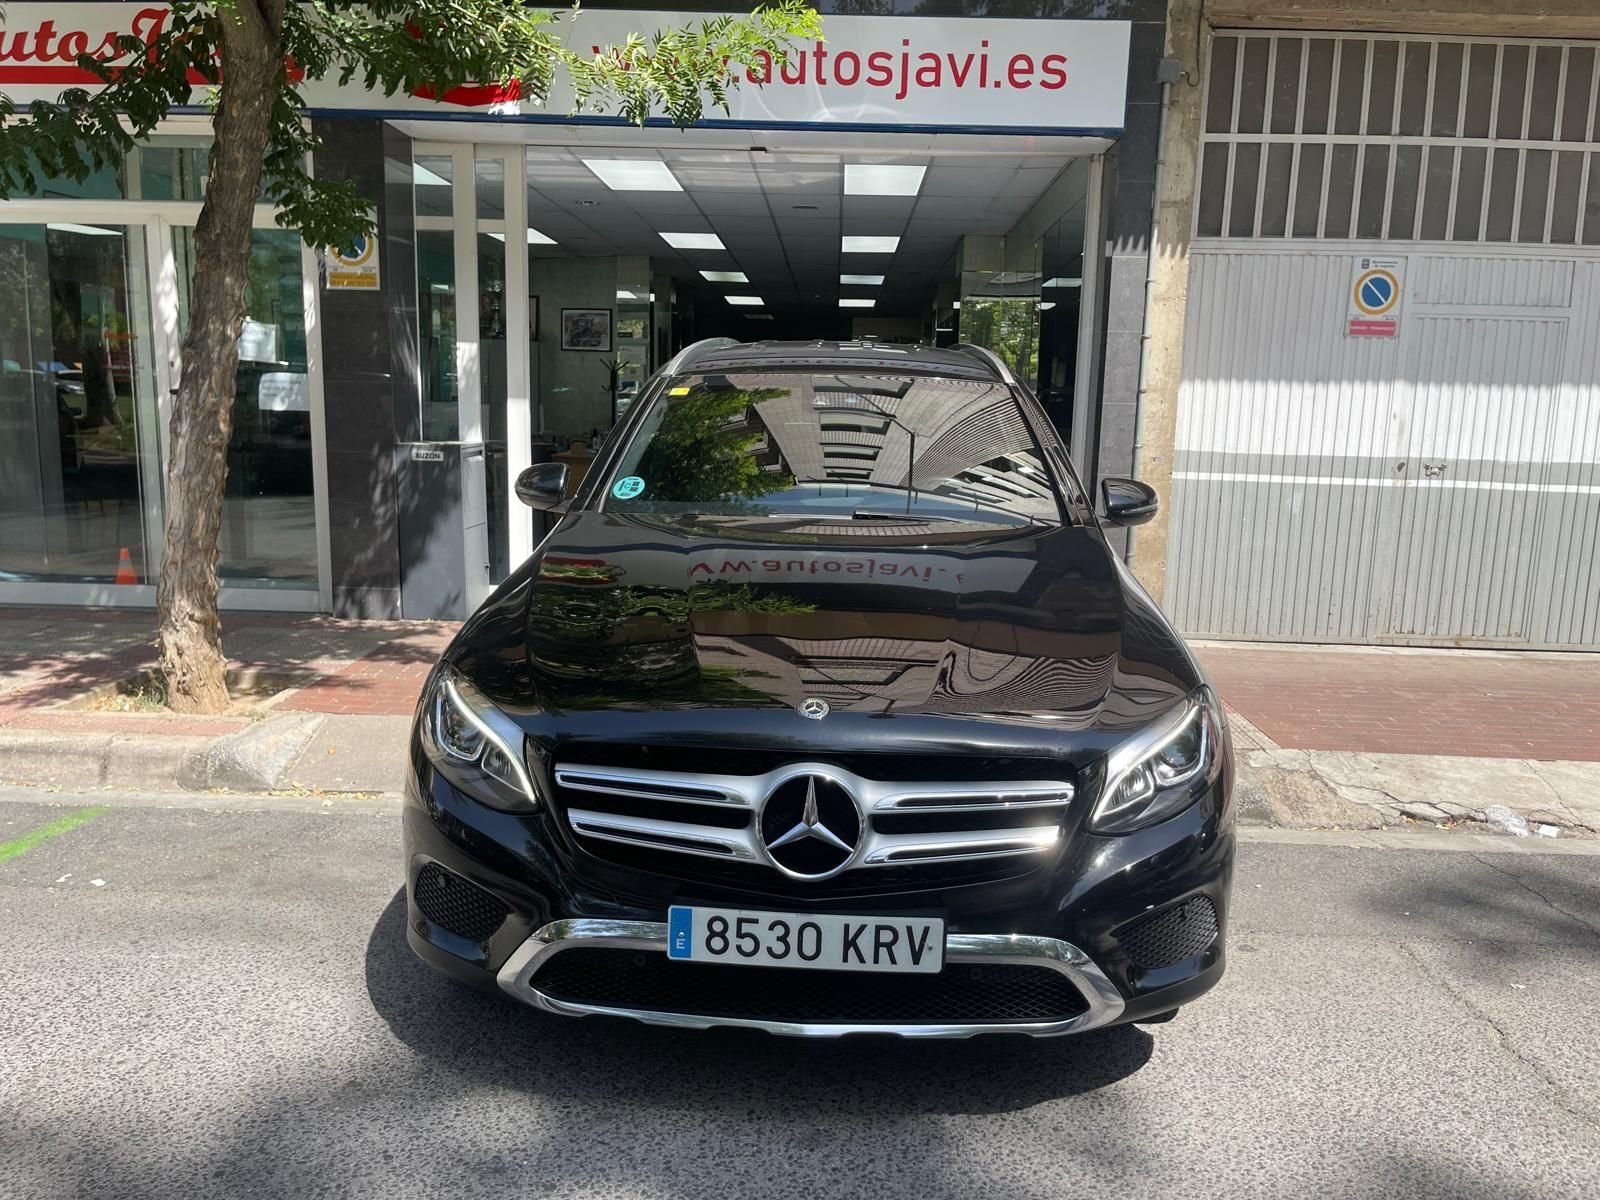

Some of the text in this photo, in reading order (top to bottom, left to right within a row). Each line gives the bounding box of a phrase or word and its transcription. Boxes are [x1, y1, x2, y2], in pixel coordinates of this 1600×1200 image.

[592, 39, 1067, 100] .autosjavi.es
[676, 938, 686, 949] E
[704, 915, 931, 966] 8530 KRV
